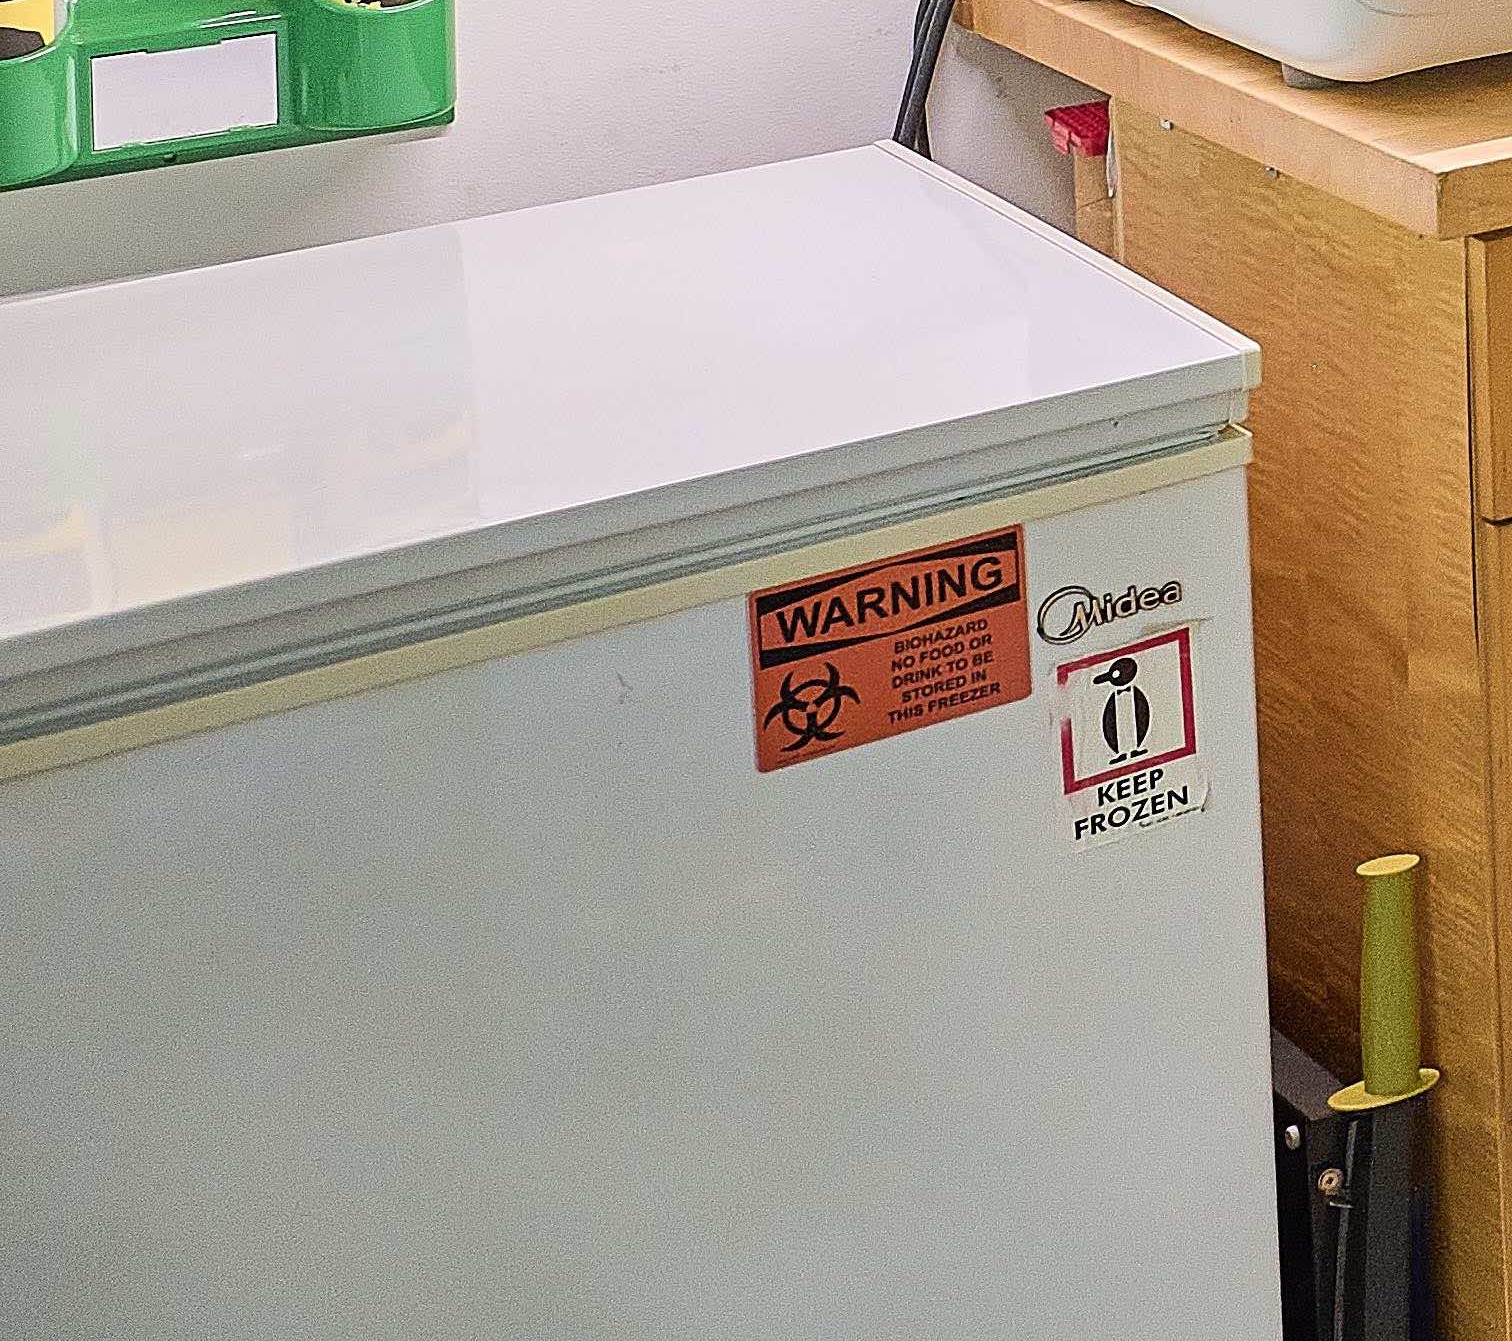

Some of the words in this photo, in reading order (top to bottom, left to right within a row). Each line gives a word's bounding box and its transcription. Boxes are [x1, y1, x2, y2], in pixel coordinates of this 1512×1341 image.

[776, 556, 1003, 643] WARNING
[1045, 580, 1183, 642] Midea
[892, 656, 915, 672] NO
[920, 641, 964, 663] FOOD
[969, 634, 992, 650] OR
[894, 619, 988, 654] BIOHAZARD
[892, 665, 942, 689] DRINK
[946, 658, 968, 672] TO
[972, 651, 994, 666] BE
[902, 675, 967, 703] STORED
[971, 669, 987, 683] IN
[888, 704, 924, 724] THIS
[928, 682, 1001, 712] FREEZER
[1097, 767, 1165, 807] KEEP
[1073, 785, 1188, 840] FROZEN
